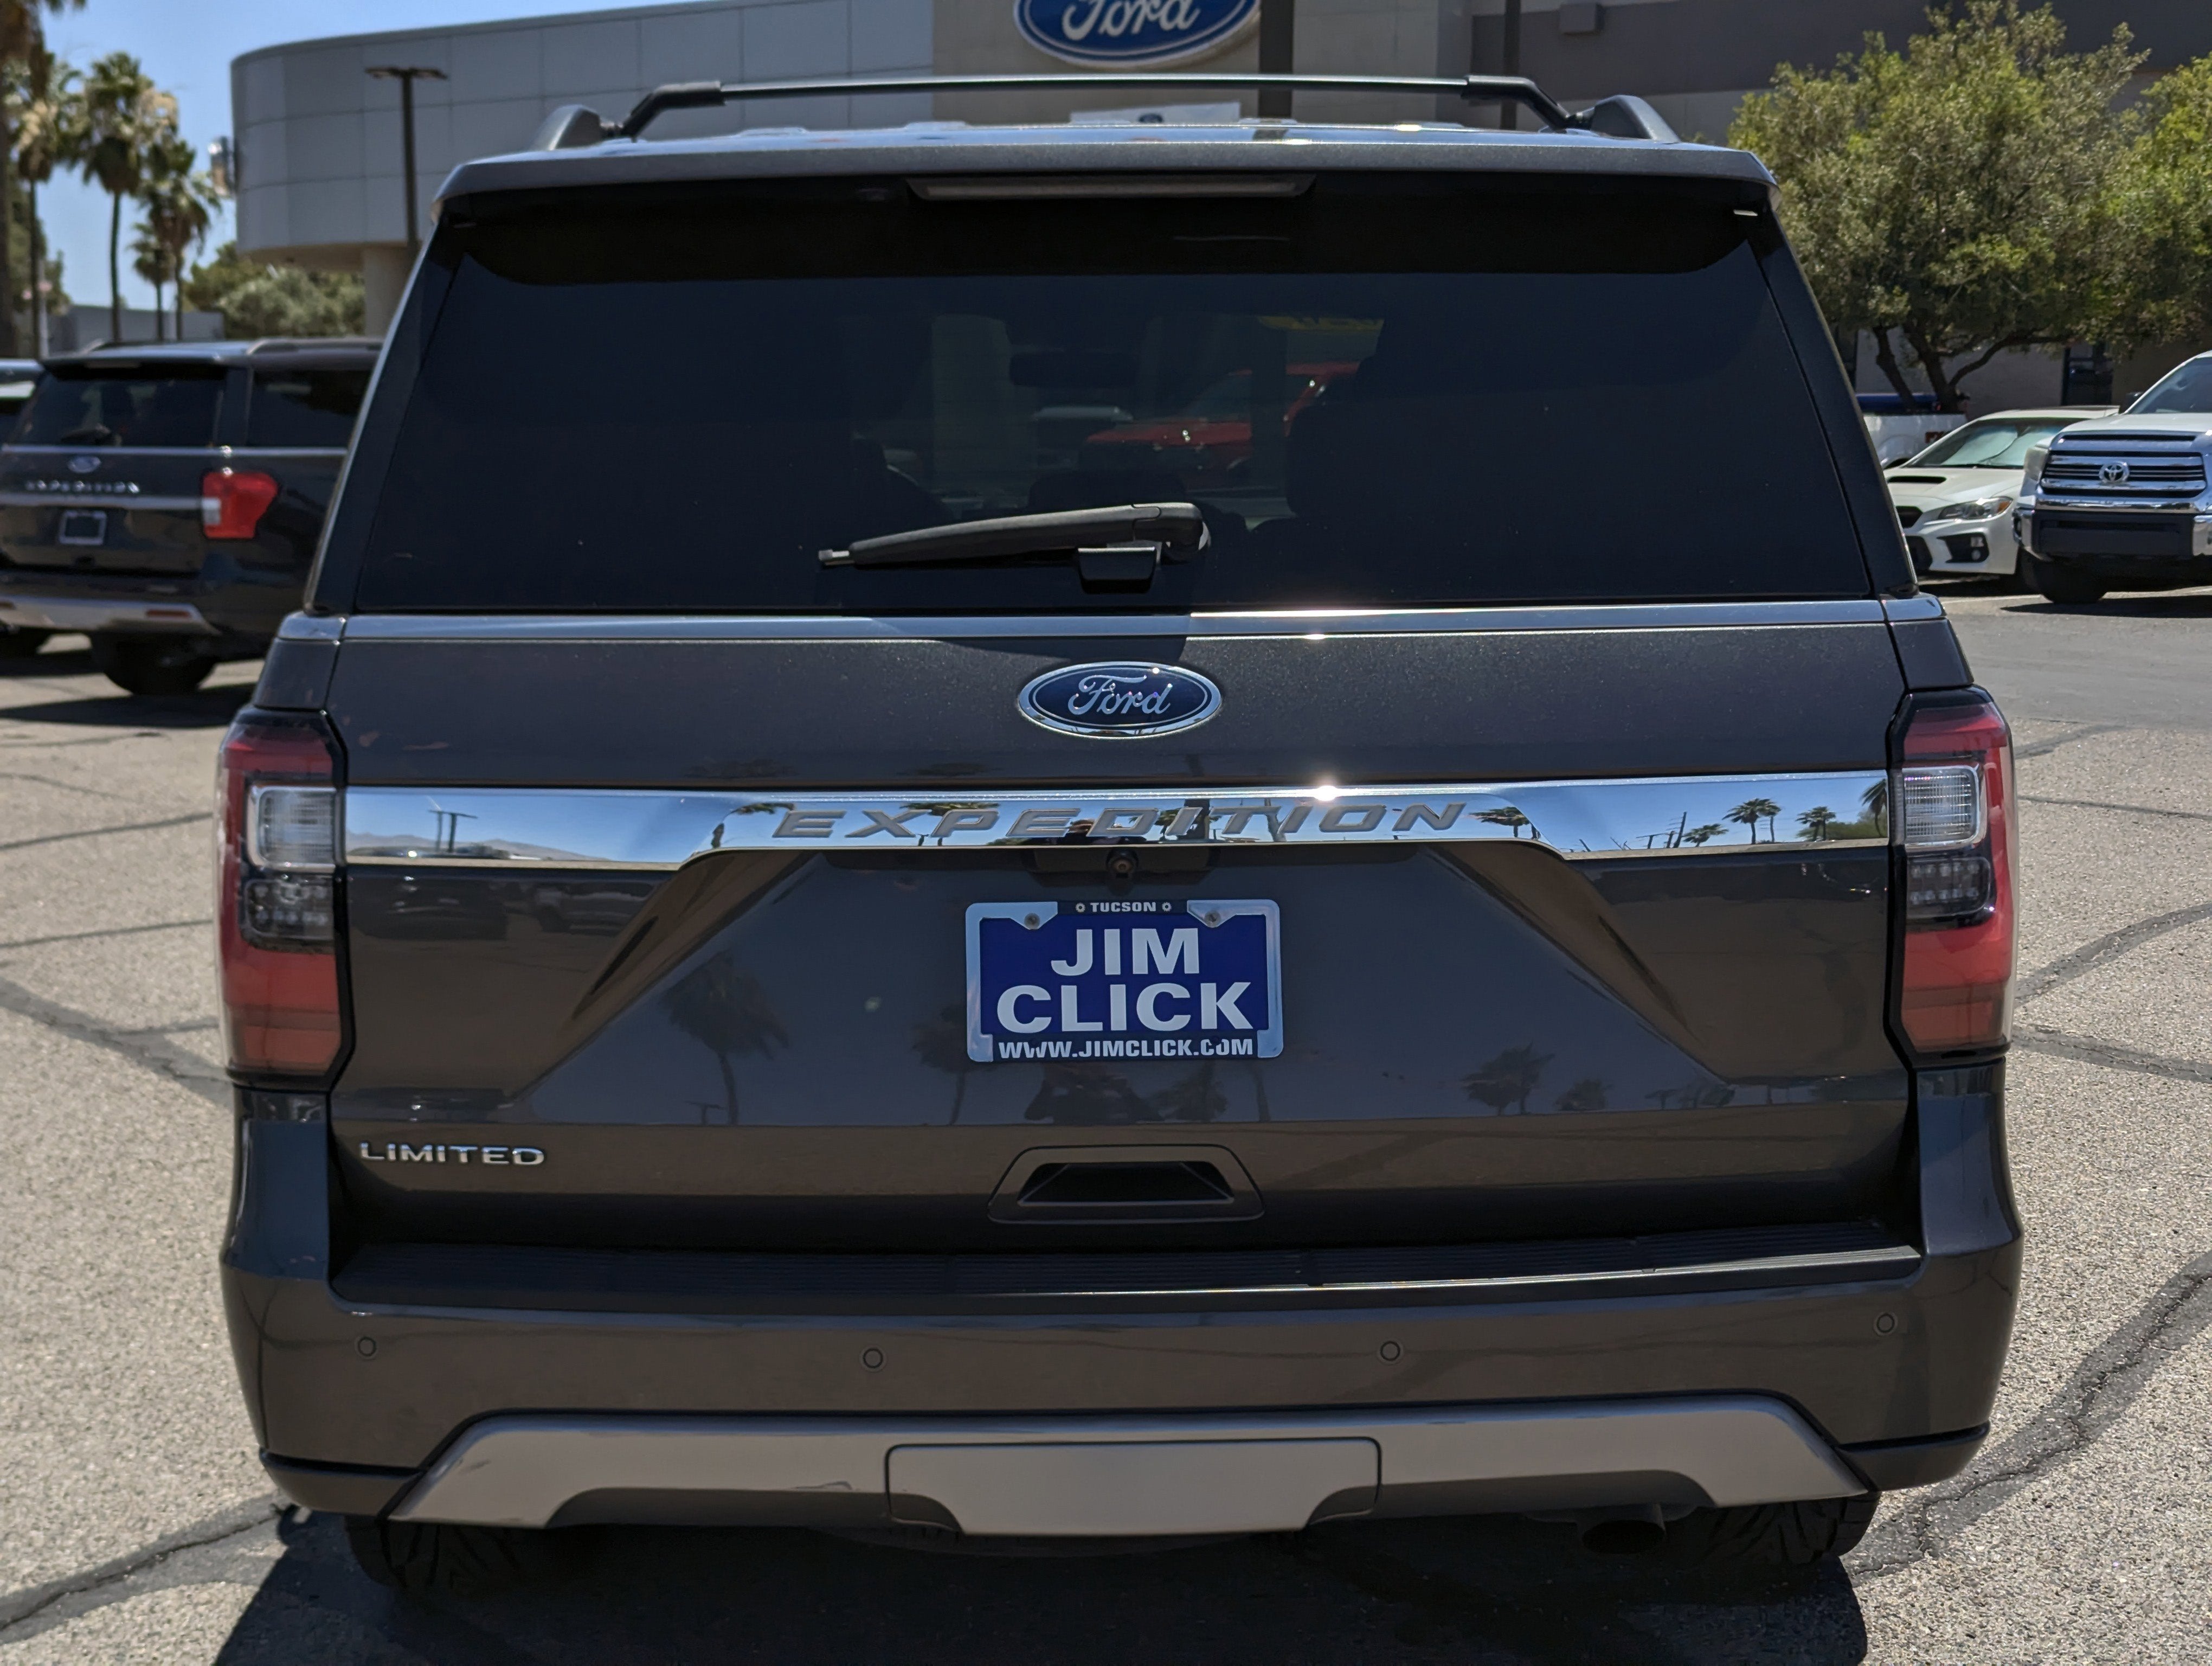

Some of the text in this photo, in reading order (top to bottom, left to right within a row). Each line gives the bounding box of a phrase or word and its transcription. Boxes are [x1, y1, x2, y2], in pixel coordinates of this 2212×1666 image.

[1068, 675, 1173, 715] Ford
[771, 803, 1467, 838] EXPEDITION
[1090, 902, 1156, 912] TUCSON
[1051, 928, 1200, 976] JIM
[997, 982, 1253, 1033] CLICK
[999, 1039, 1253, 1059] WWW.JIMCLICK.COM
[360, 1142, 544, 1165] LIMITED
